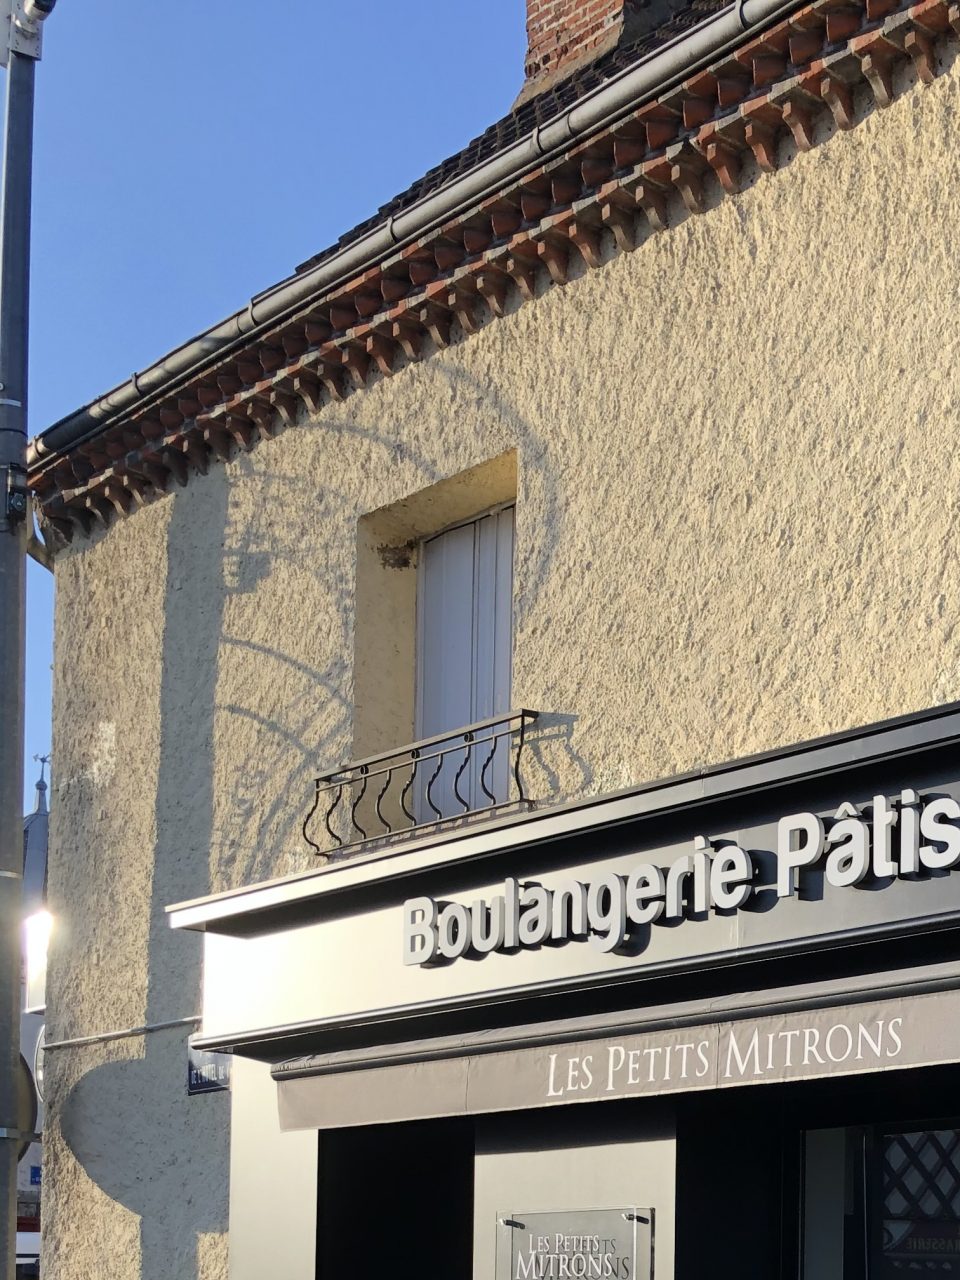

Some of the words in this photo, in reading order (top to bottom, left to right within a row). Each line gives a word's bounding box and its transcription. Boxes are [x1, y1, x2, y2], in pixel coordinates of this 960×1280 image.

[403, 834, 752, 966] Boulangerie
[547, 1053, 593, 1097] LES
[605, 1040, 709, 1091] PETITS
[724, 1017, 902, 1078] MITRONS
[516, 1250, 613, 1280] MITRONS
[528, 1233, 550, 1254] LES
[554, 1233, 600, 1254] PETITS
